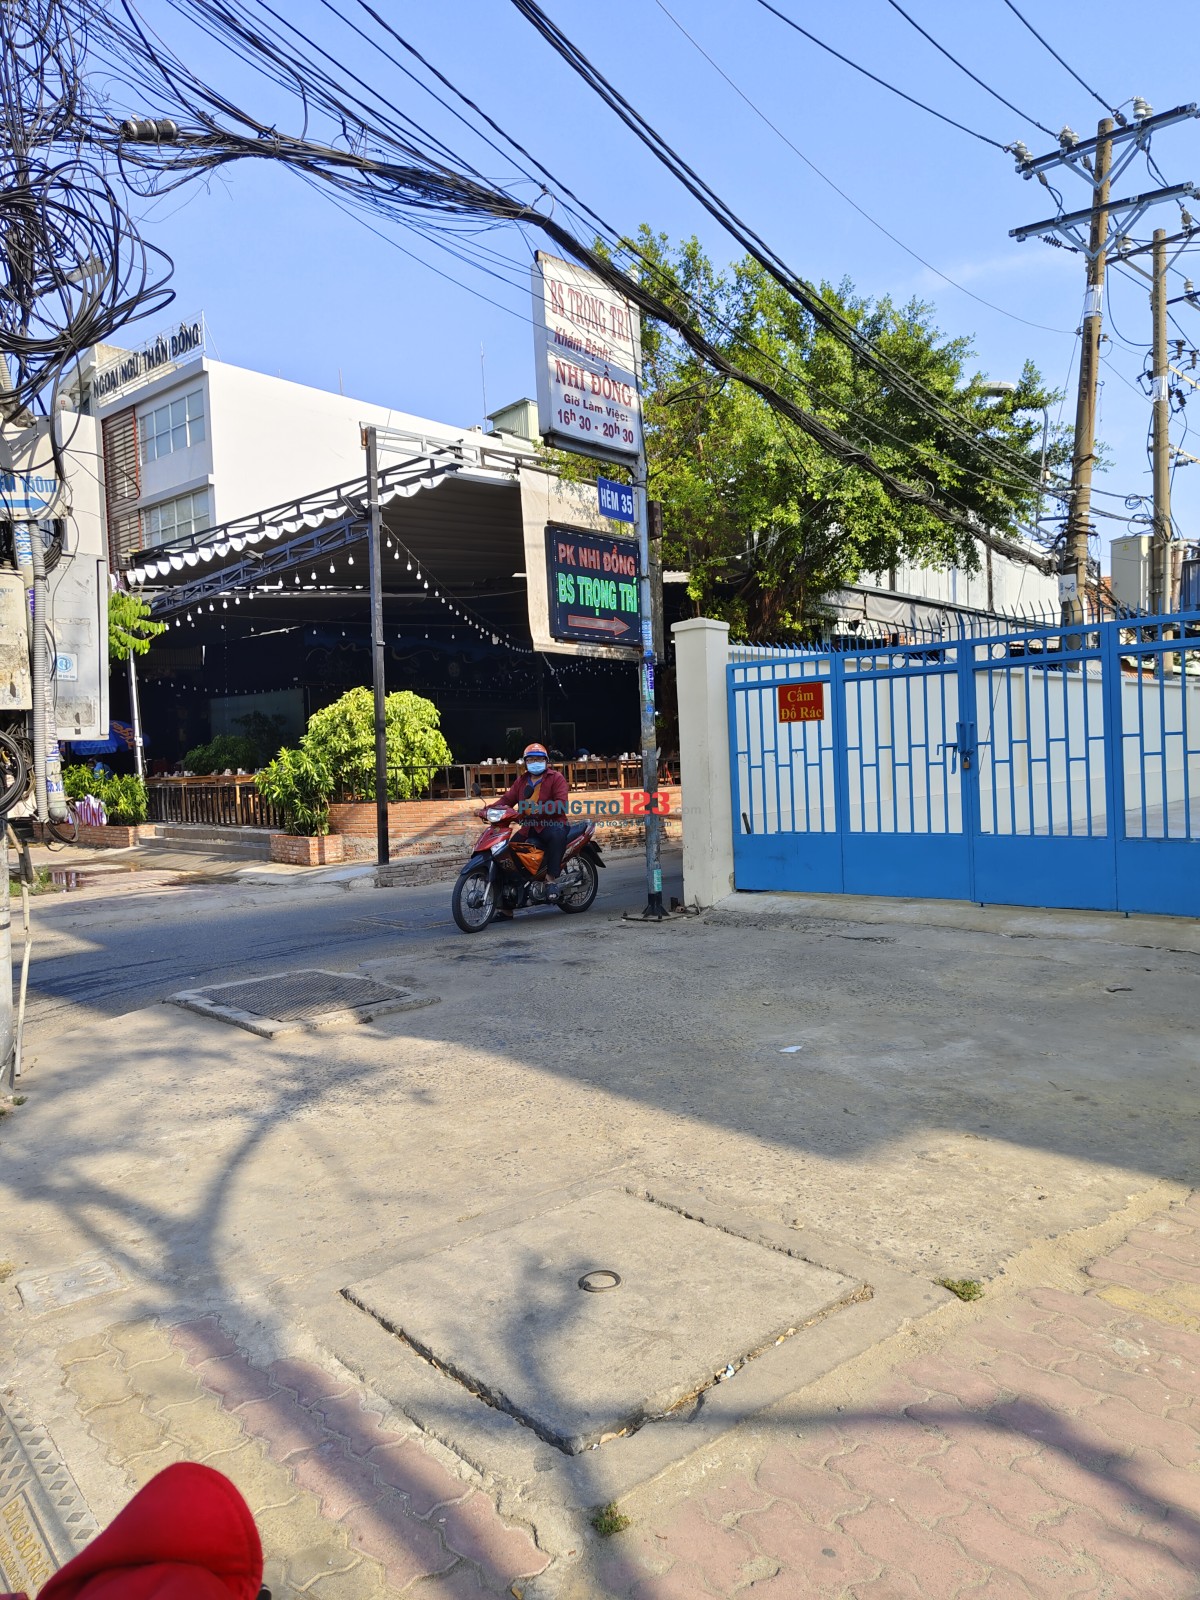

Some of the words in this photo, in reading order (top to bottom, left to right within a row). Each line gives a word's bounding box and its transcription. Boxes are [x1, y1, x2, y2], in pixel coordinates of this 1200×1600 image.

[567, 287, 606, 335] TRỌNG
[554, 325, 582, 352] Khám
[121, 351, 140, 384] NGỮ
[555, 359, 585, 392] NHI
[591, 364, 632, 408] ĐỒNG
[564, 393, 580, 407] Giờ
[583, 399, 603, 415] Làm
[605, 406, 628, 423] Việc:
[557, 408, 576, 426] 16h
[578, 415, 591, 432] 30
[602, 422, 620, 439] 20h
[622, 428, 634, 444] 30
[600, 484, 619, 512] HẺM
[621, 494, 633, 515] 35
[558, 542, 576, 567] PK
[579, 547, 600, 570] NHI
[603, 545, 636, 577] ĐỒNG
[558, 572, 576, 605] BS
[577, 575, 617, 617] TRỌNG
[619, 577, 638, 613] TRÍ
[787, 686, 814, 702] Cấm
[781, 704, 797, 720] Đổ
[800, 706, 822, 719] Rác
